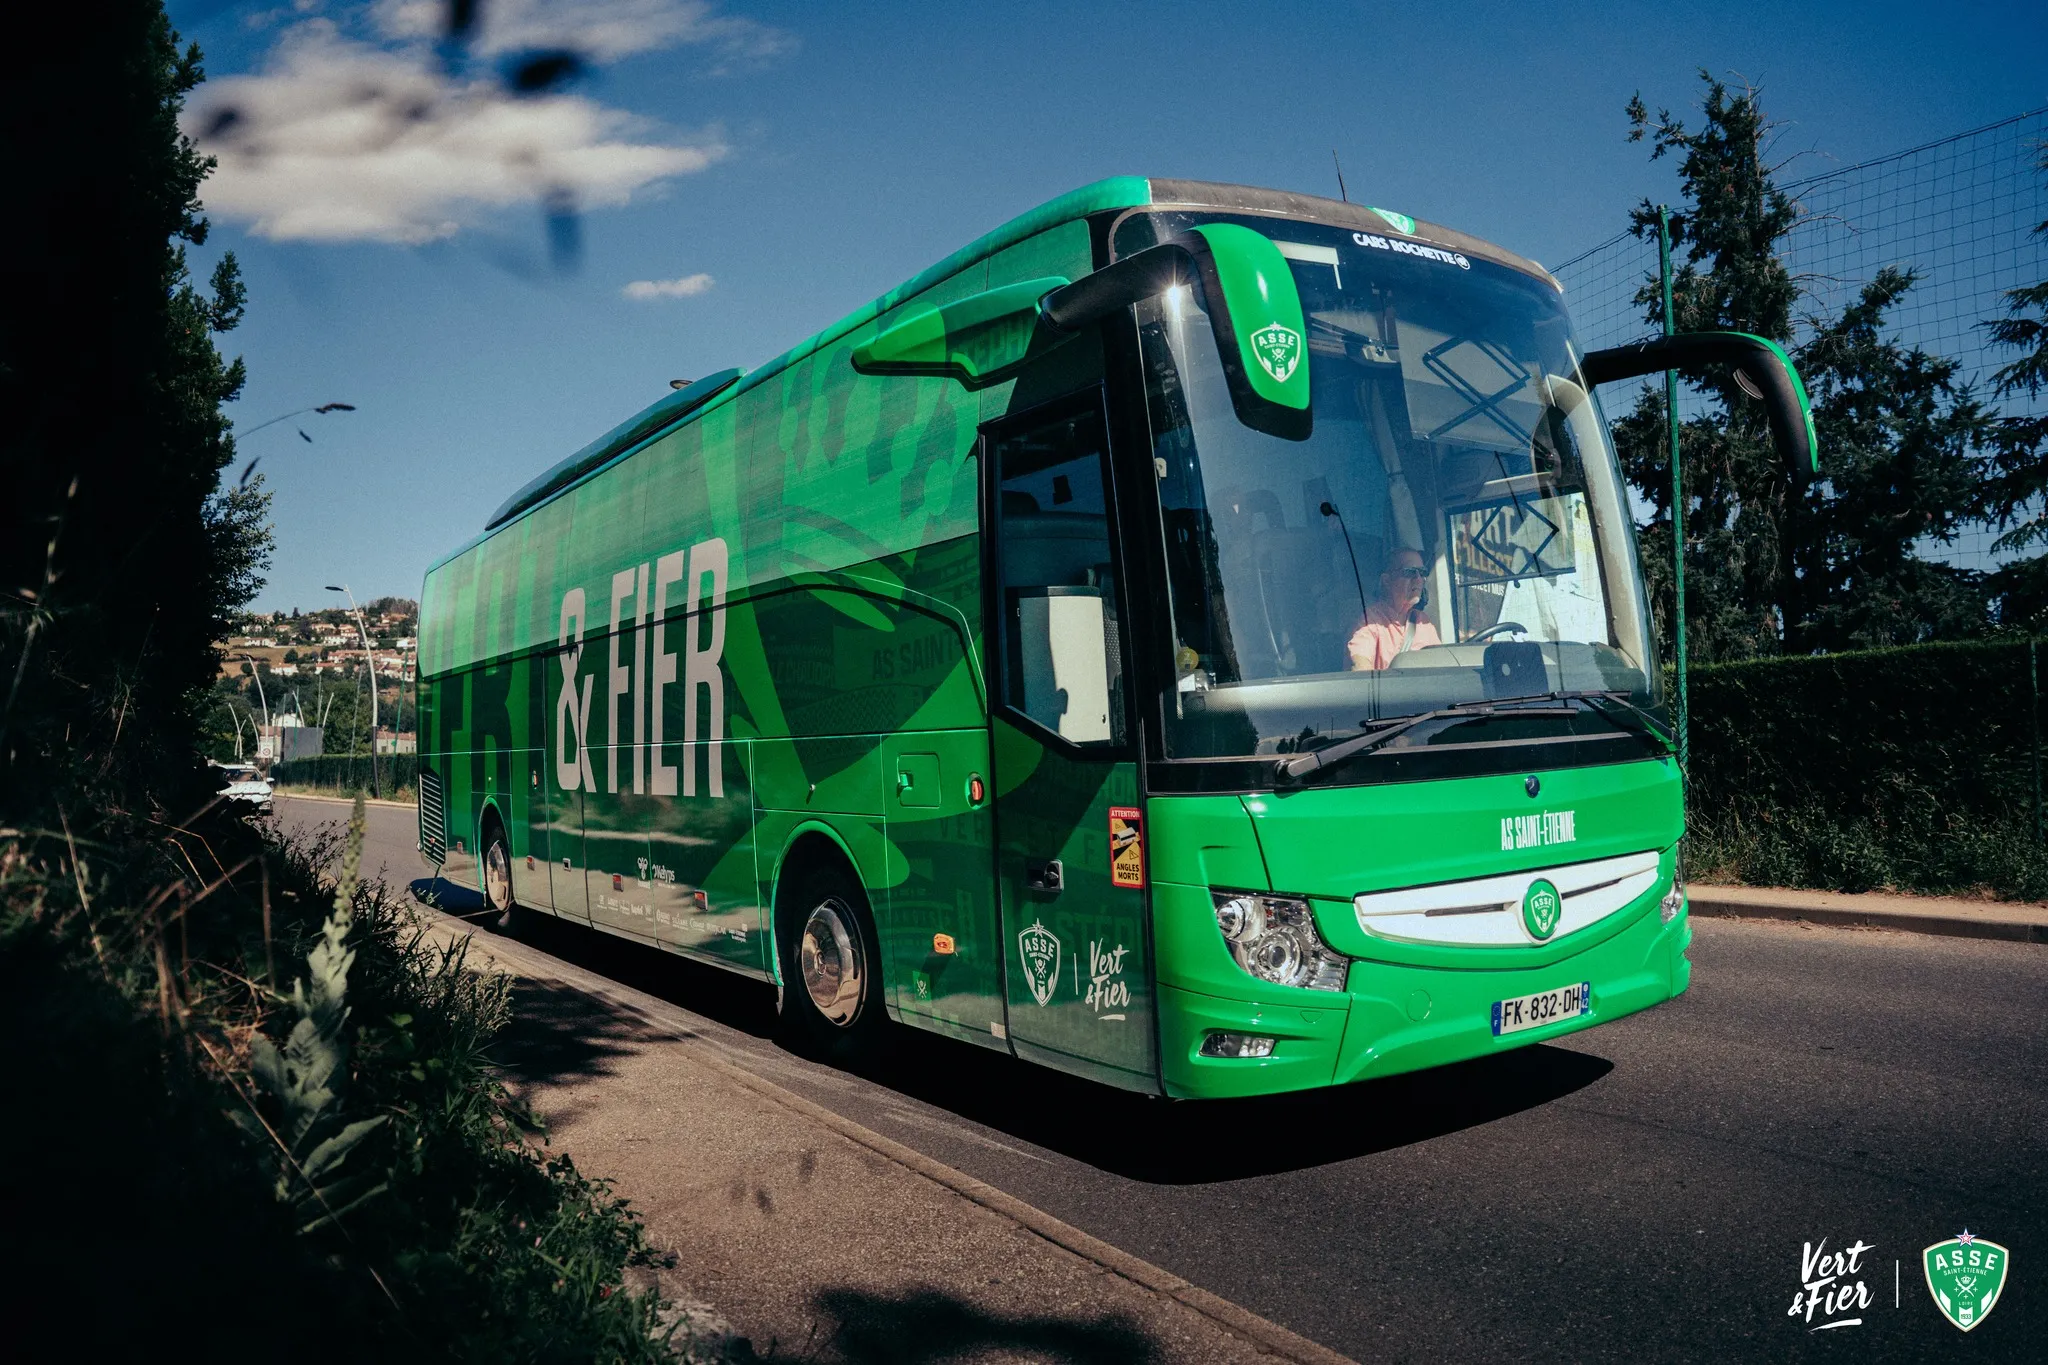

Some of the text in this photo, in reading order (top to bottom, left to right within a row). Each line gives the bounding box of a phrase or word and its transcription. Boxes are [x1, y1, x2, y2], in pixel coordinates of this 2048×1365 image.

[1353, 233, 1457, 265] CARS ROCHETTE
[1258, 332, 1295, 347] ASSE
[556, 537, 729, 798] & FIER
[1111, 809, 1141, 819] ATTENTION
[1501, 809, 1577, 851] AS SAINT-ÉTIENNE
[1116, 862, 1140, 873] ANGLES
[1117, 871, 1140, 881] MORTS
[1024, 937, 1055, 959] ASSE
[1089, 937, 1130, 978] Vert
